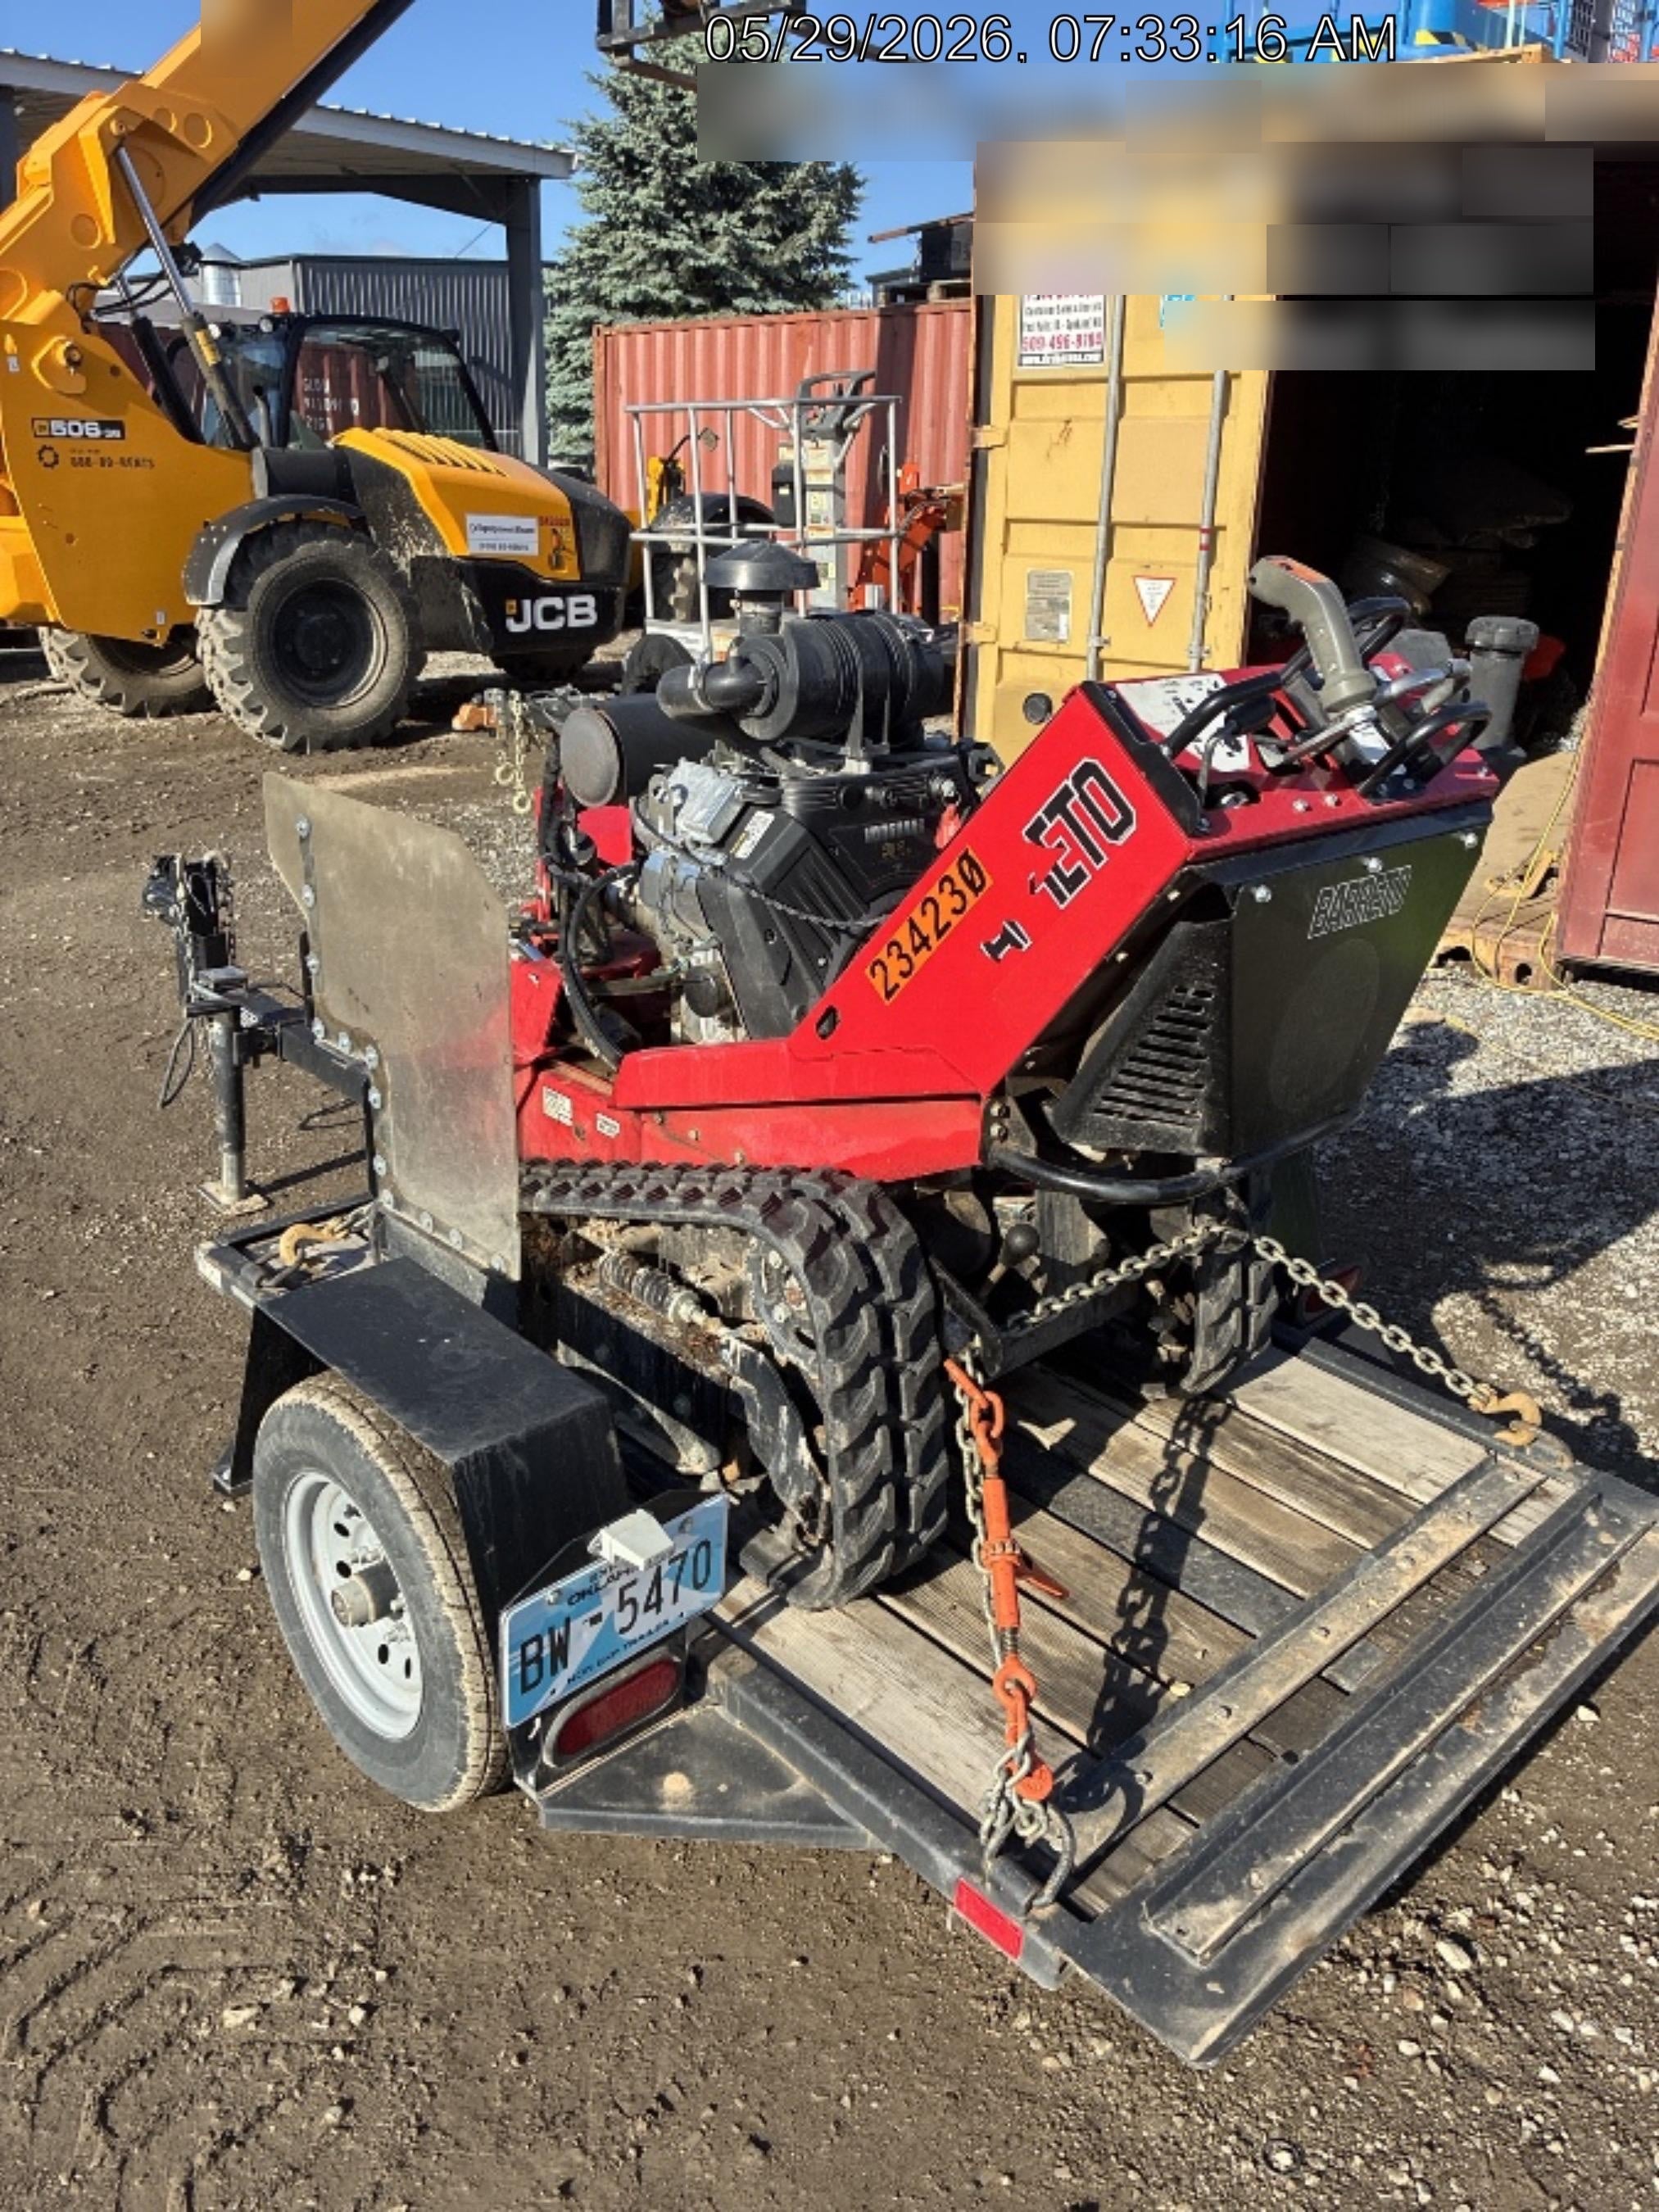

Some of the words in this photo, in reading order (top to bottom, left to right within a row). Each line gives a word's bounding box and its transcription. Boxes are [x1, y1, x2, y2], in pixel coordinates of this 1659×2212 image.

[505, 594, 598, 632] JCB
[520, 1616, 570, 1696] BW
[617, 1539, 712, 1635] 5470
